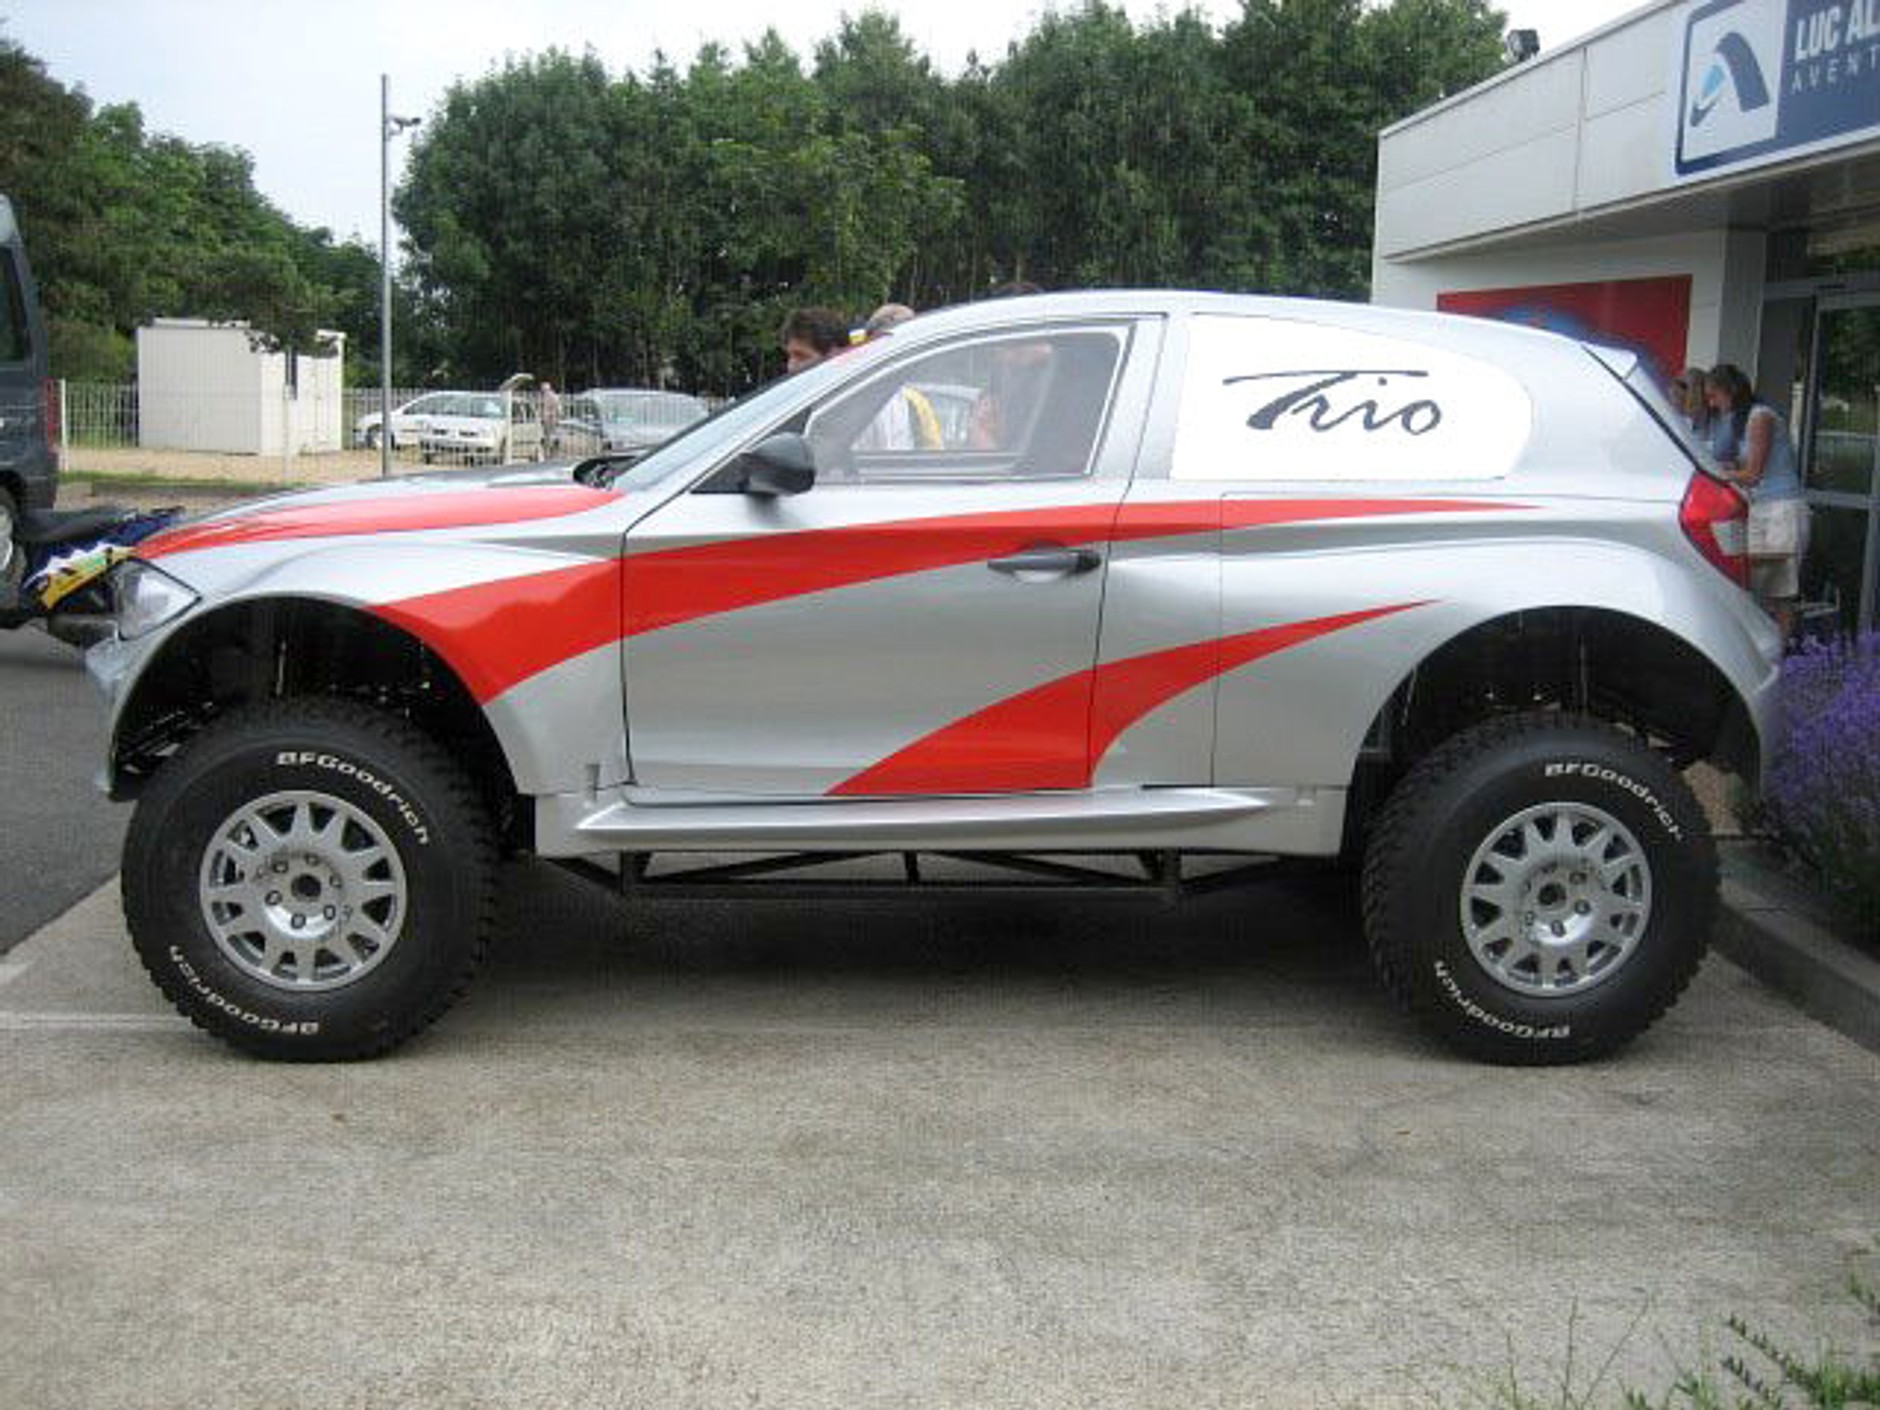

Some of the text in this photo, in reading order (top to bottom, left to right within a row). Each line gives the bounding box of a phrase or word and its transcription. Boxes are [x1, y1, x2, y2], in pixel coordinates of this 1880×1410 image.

[1795, 6, 1840, 61] LUC
[1222, 369, 1442, 436] Trio
[276, 751, 430, 845] BFGoodrich
[1545, 763, 1683, 842] BFGoodrich
[170, 945, 319, 1035] BFGoodrich
[1434, 961, 1571, 1038] BFGoodrich
